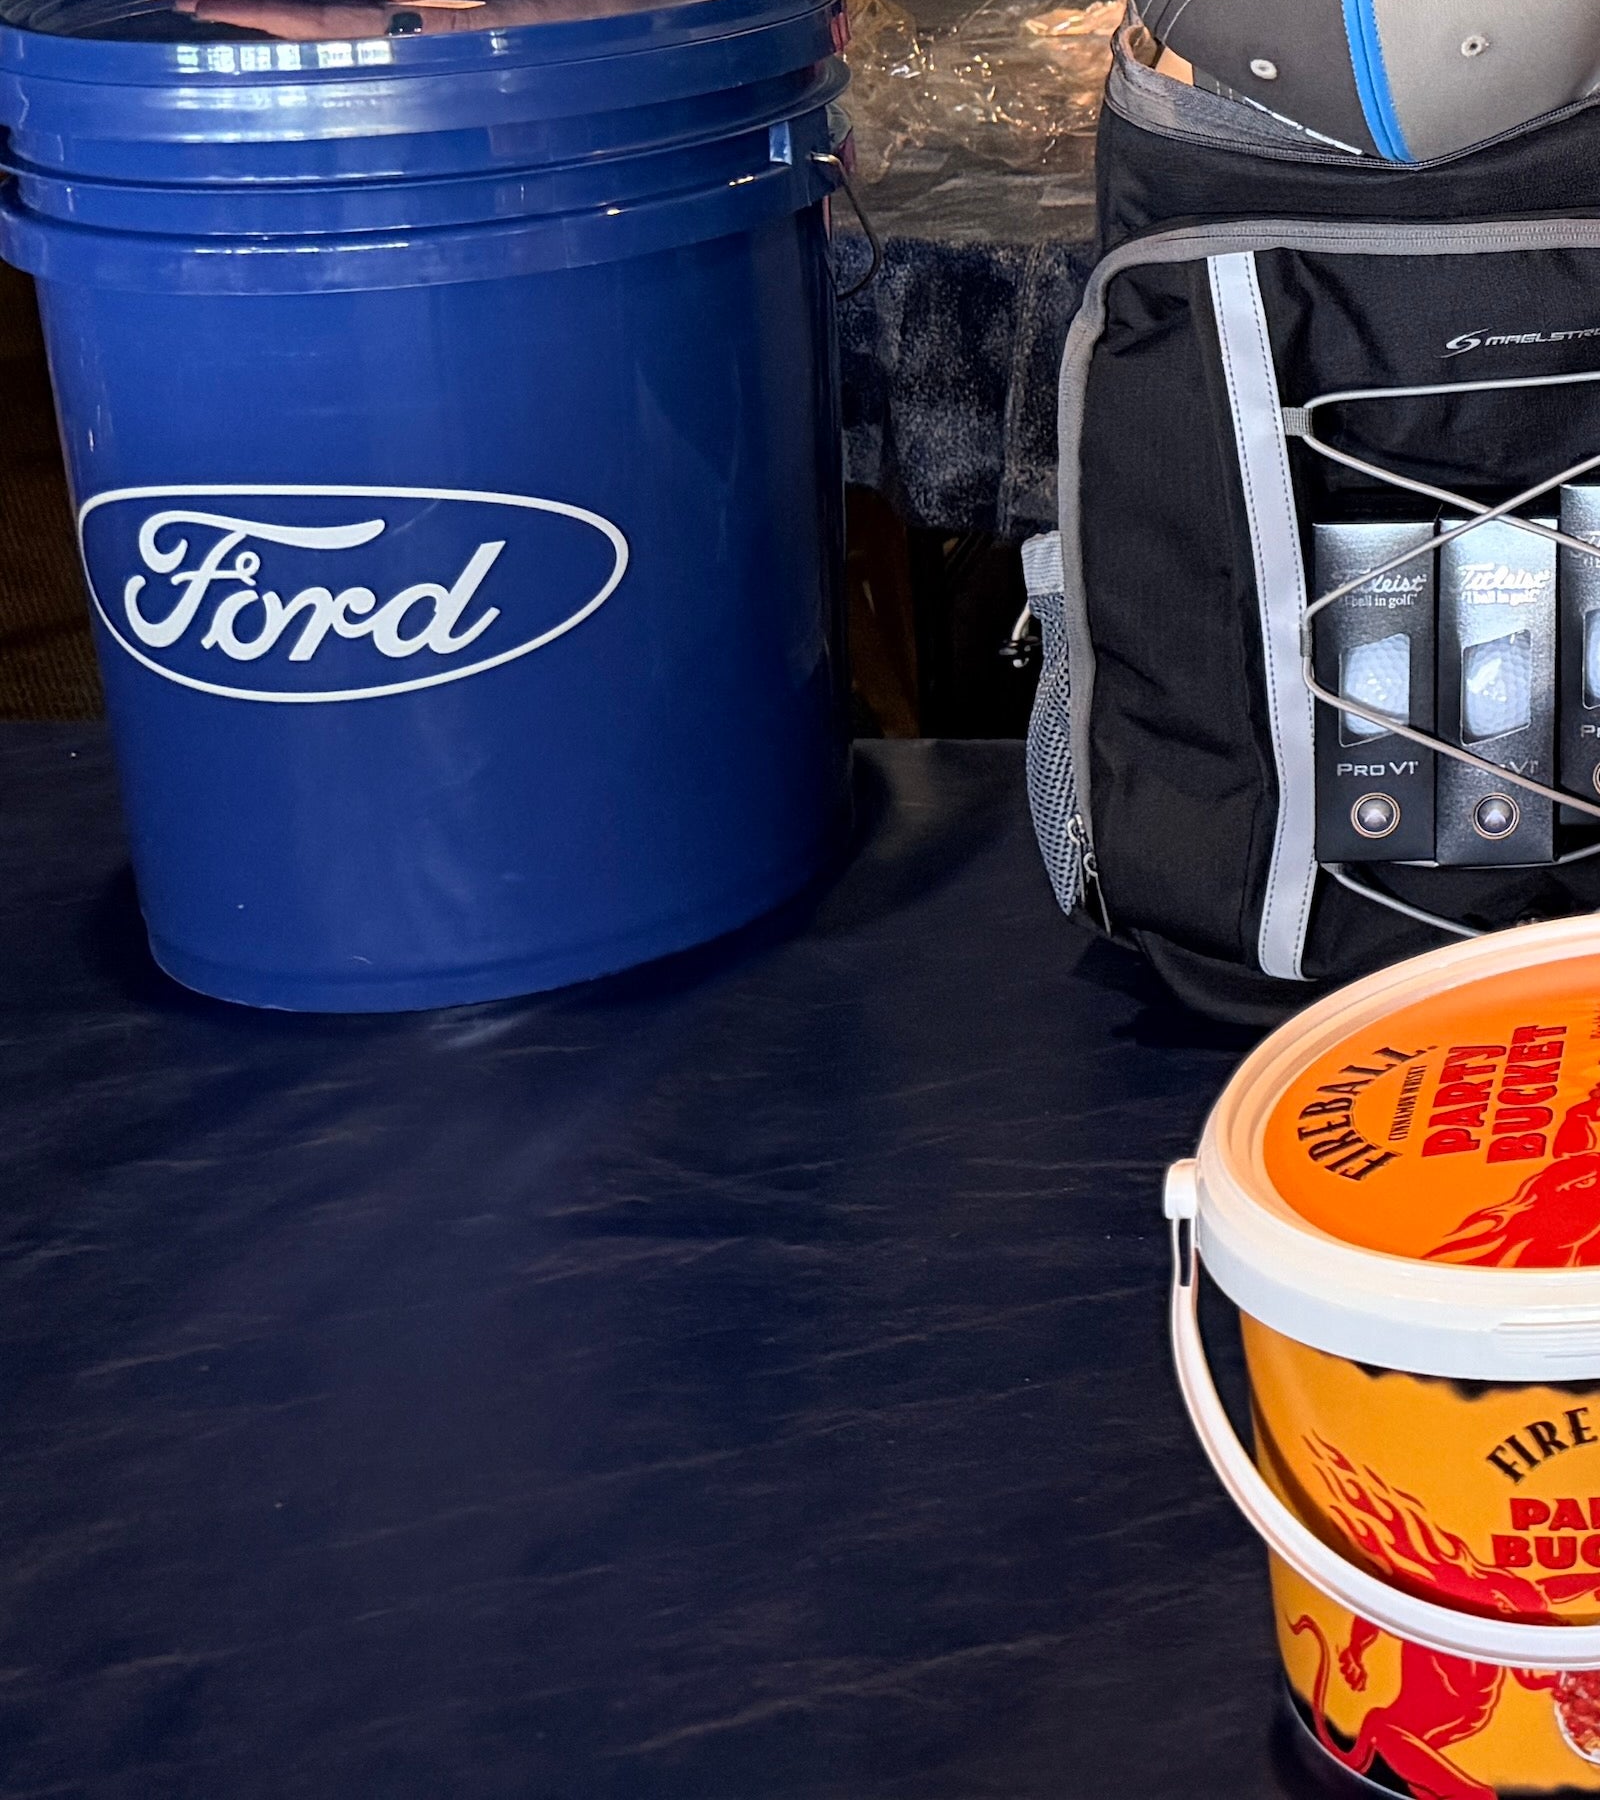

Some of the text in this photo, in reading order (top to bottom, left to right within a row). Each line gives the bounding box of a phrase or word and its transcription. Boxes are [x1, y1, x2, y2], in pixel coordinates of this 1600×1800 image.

[124, 510, 506, 662] Ford
[1297, 1045, 1428, 1182] FIREBALL
[1422, 1043, 1508, 1160] PARTY
[1485, 1022, 1569, 1165] BUCKET
